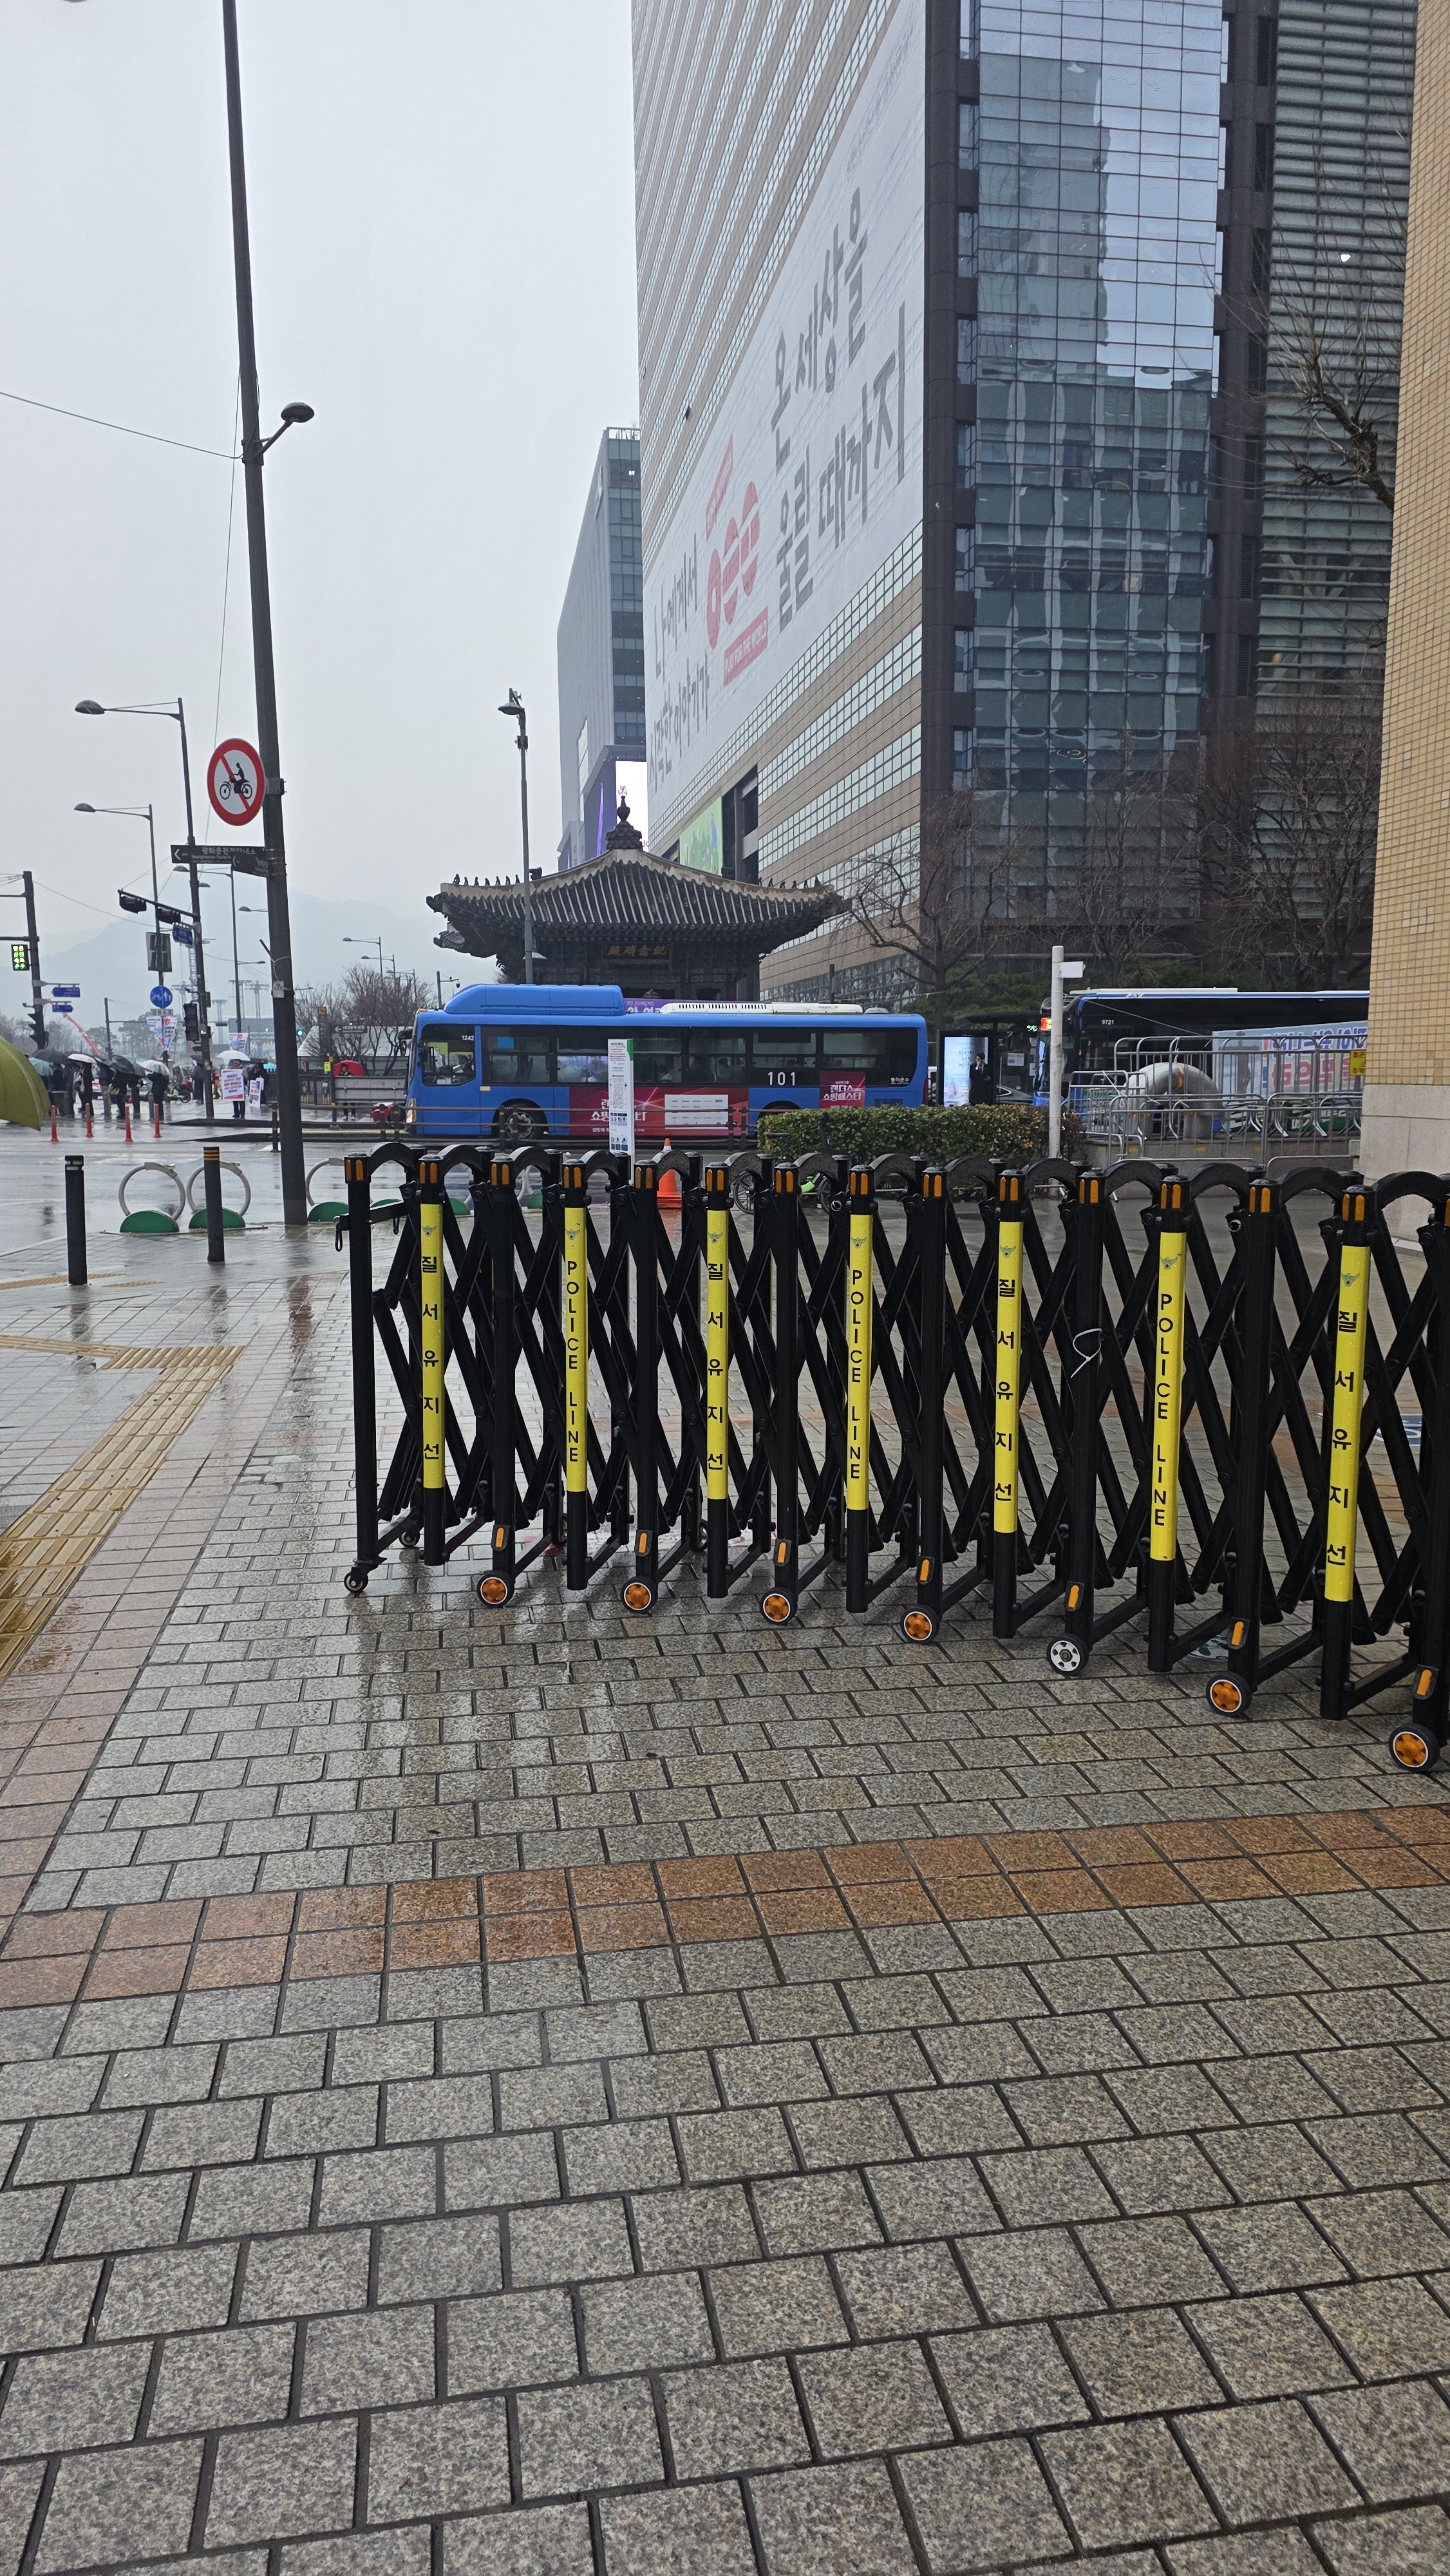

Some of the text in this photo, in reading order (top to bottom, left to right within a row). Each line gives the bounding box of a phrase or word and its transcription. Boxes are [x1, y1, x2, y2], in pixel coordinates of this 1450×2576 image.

[771, 329, 791, 475] 온
[795, 186, 867, 394] 세상을
[776, 301, 905, 633] 울릴 때까지
[649, 651, 710, 794] 시작한 이야기가
[768, 1071, 796, 1086] 101
[823, 1091, 862, 1101] 쇼핑페스타
[422, 1256, 440, 1461] 질서유지선
[567, 1260, 579, 1462] POLICE LINE
[707, 1263, 724, 1471] 질서유지선
[850, 1269, 863, 1479] POLICE LINE
[995, 1278, 1015, 1501] 질서유지선
[1154, 1293, 1174, 1526] POLICE LINE
[1326, 1310, 1358, 1566] 질서유지선
